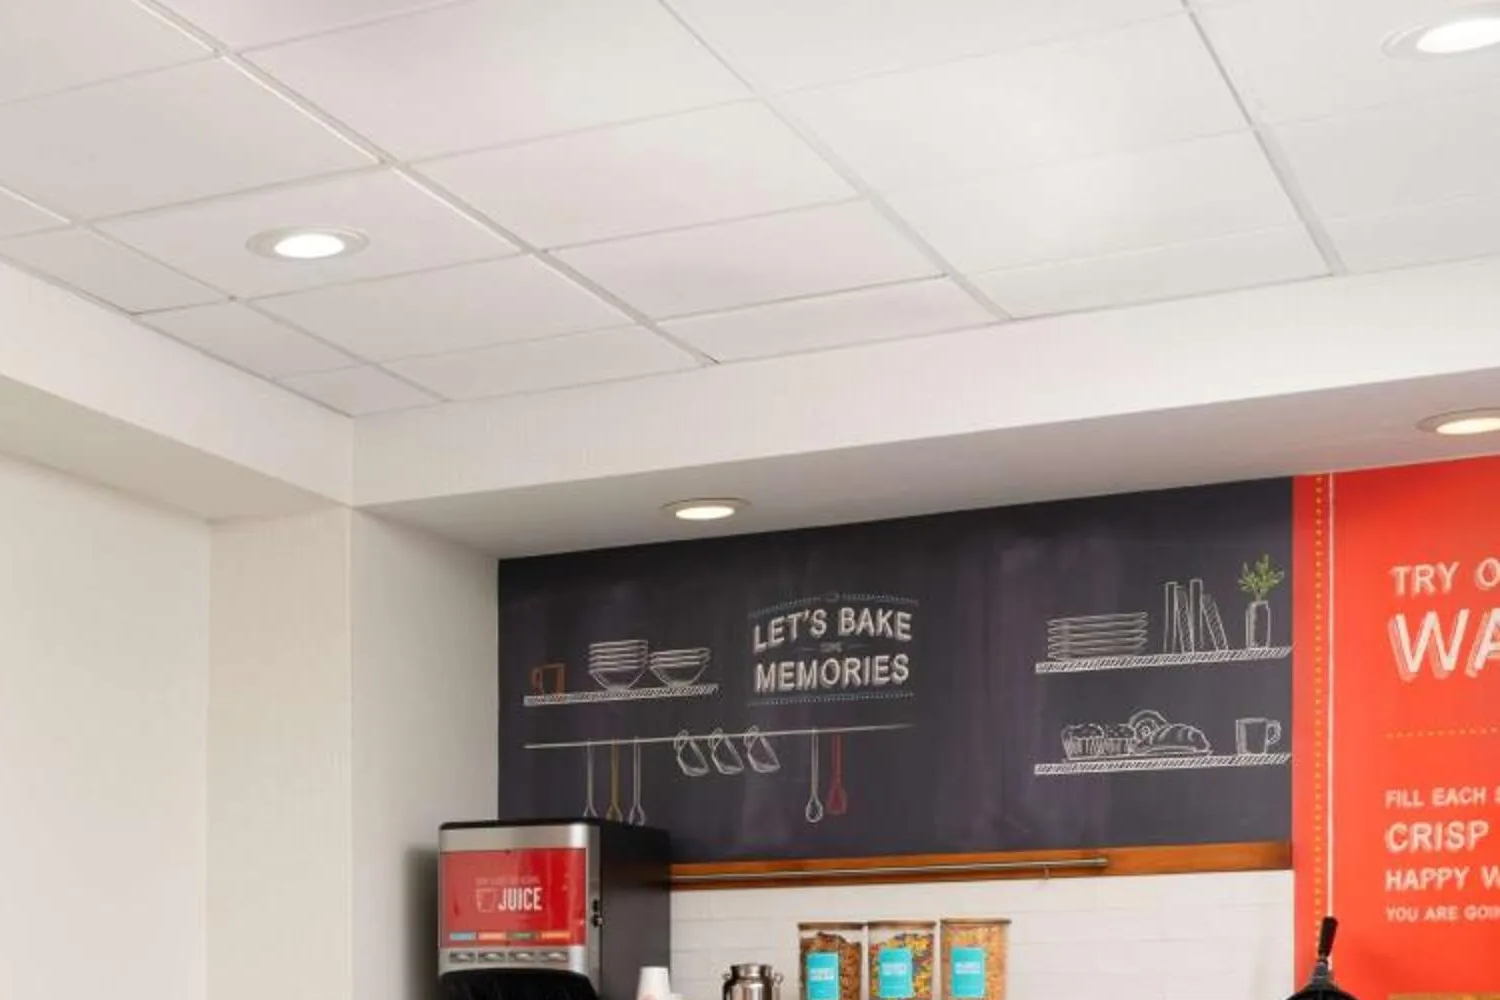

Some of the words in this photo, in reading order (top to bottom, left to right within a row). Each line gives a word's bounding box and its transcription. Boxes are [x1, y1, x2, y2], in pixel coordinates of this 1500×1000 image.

[1390, 561, 1460, 597] TRY
[754, 609, 827, 653] LET'S
[838, 607, 913, 641] BAKE
[755, 653, 910, 693] MEMORIES
[1385, 788, 1424, 808] FILL
[1431, 786, 1487, 808] EACH
[1385, 820, 1489, 853] CRISP
[1384, 865, 1470, 892] HAPPY
[498, 887, 543, 912] JUICE
[1386, 906, 1419, 922] YOU
[1424, 905, 1459, 922] ARE
